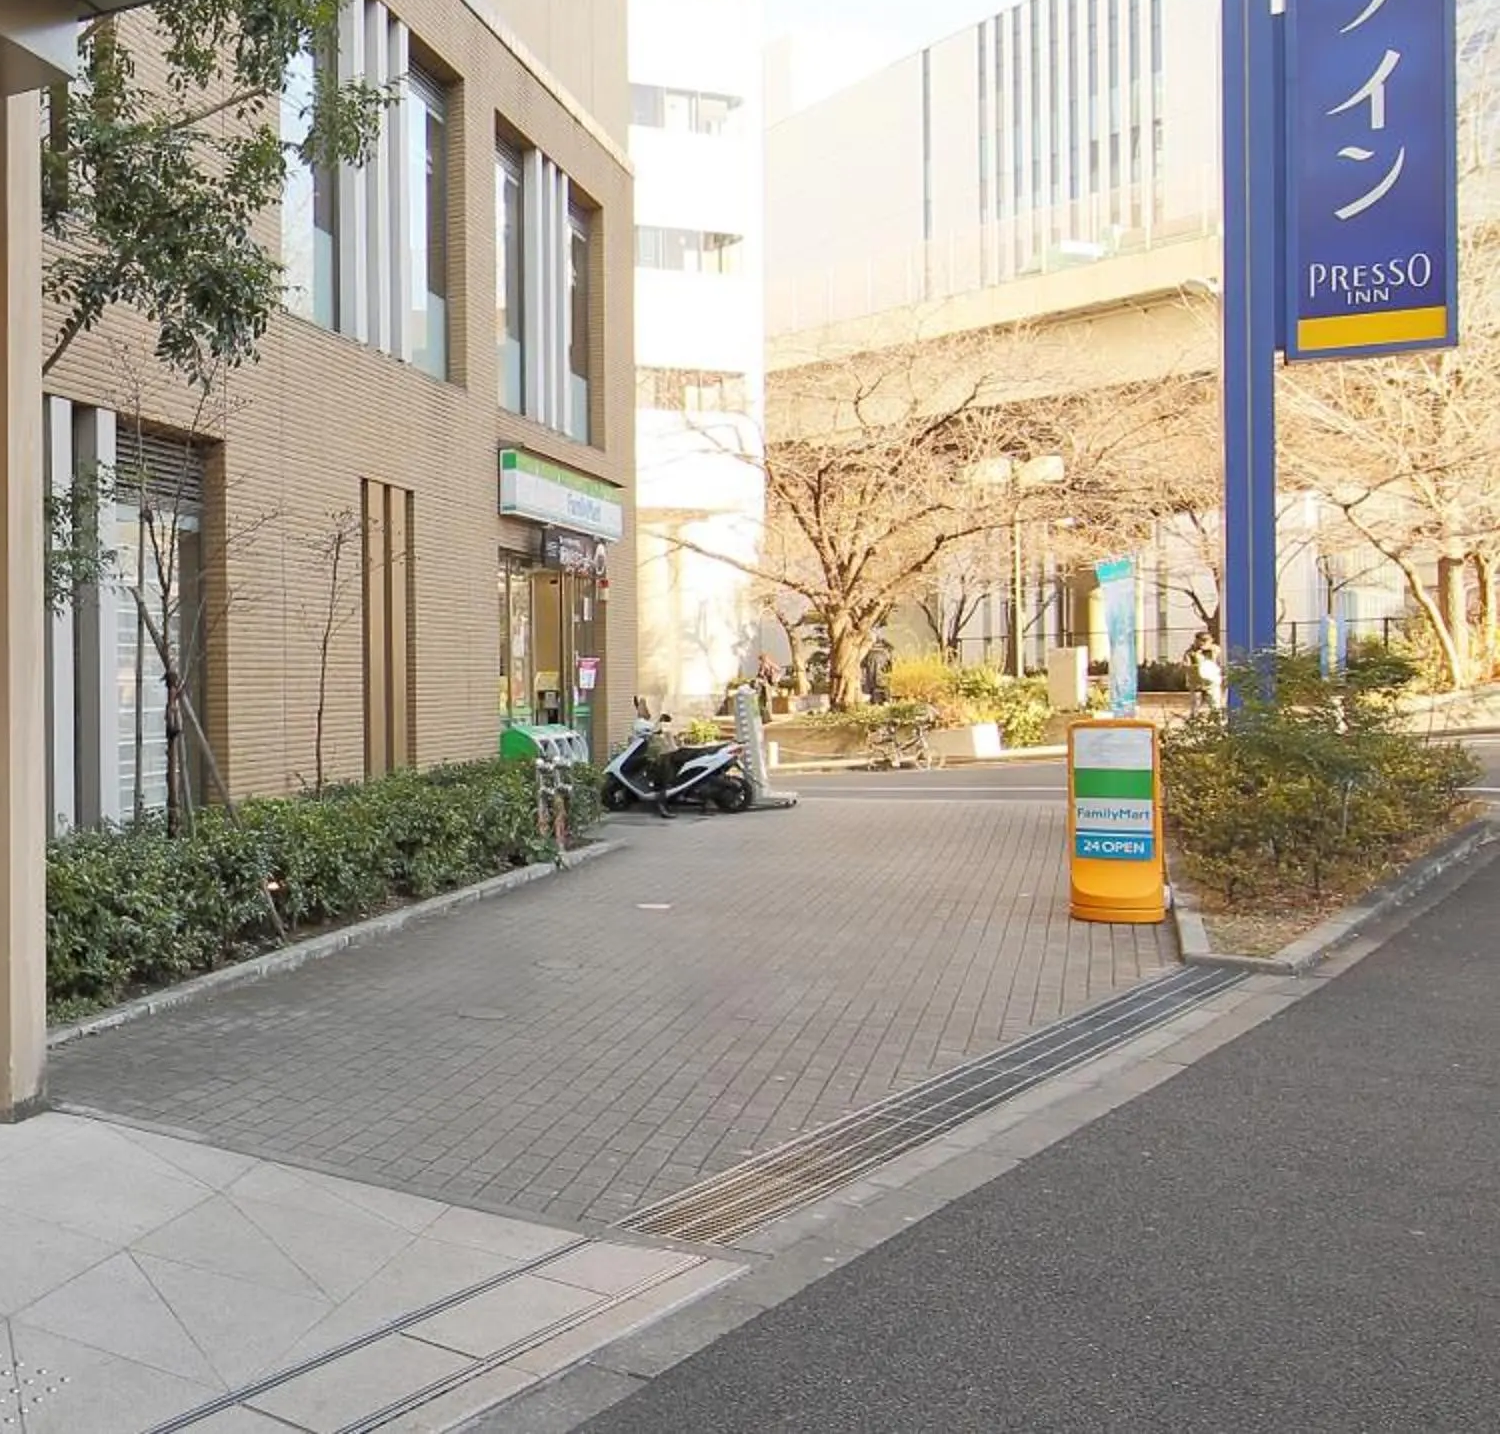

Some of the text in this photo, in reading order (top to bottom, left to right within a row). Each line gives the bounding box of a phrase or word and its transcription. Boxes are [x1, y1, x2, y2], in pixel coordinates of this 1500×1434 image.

[1309, 253, 1431, 298] PRESSO
[1347, 287, 1389, 305] INN
[1077, 807, 1150, 820] FamilyMart
[1083, 839, 1145, 854] 24 OPEN
